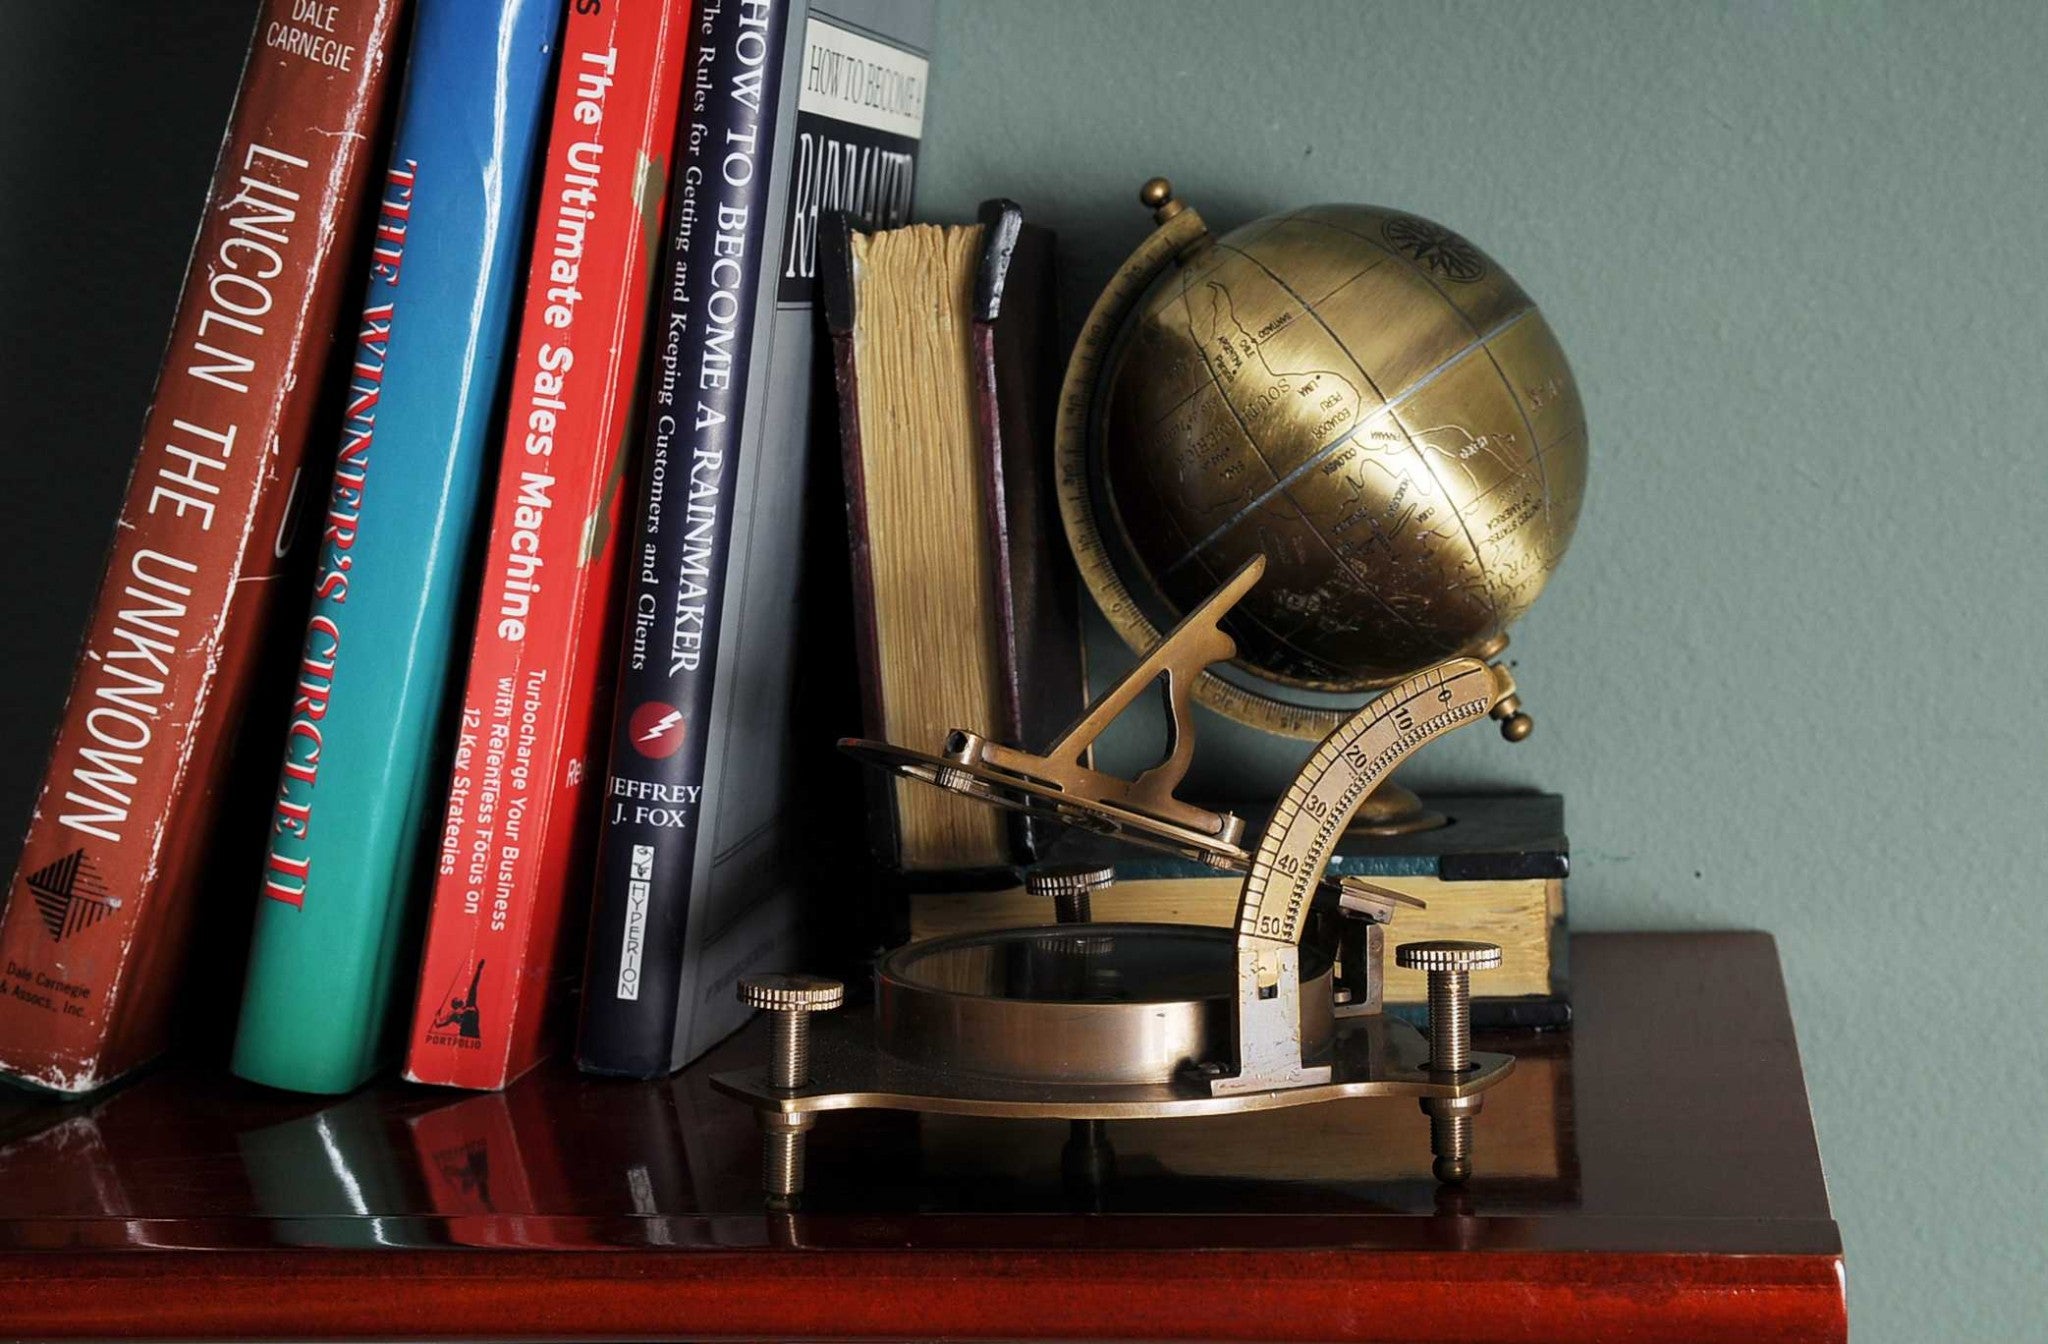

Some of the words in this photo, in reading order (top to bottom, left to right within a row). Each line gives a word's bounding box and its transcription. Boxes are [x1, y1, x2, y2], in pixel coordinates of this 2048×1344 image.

[292, 0, 340, 33] DALE
[266, 21, 356, 72] CARNEGIE
[730, 0, 771, 114] HOW
[807, 45, 845, 97] HOW
[573, 47, 618, 125] The
[693, 46, 716, 112] Rules
[689, 122, 708, 156] for
[722, 123, 758, 187] TO
[370, 159, 418, 287] THE
[543, 140, 604, 329] Ultimate
[676, 165, 703, 252] Getting
[188, 143, 309, 394] LINCOLN
[672, 260, 690, 302] and
[700, 201, 749, 390] BECOME
[658, 312, 687, 406] Keeping
[525, 342, 574, 457] Sales
[695, 400, 727, 431] A
[1298, 379, 1319, 397] LIMA
[1319, 391, 1343, 412] PERU
[1311, 407, 1352, 440] ECUADOR
[148, 418, 237, 531] THE
[646, 414, 676, 534] Customers
[1415, 506, 1436, 524] CUBA
[498, 471, 556, 642] Machine
[642, 543, 659, 584] and
[668, 447, 724, 678] RAINMAKER
[632, 593, 656, 671] Clients
[59, 549, 198, 842] UNKNOWN
[462, 707, 481, 729] 12
[493, 677, 513, 718] with
[1394, 707, 1414, 732] 10
[275, 615, 340, 841] CIRCLE
[454, 733, 478, 771] Key
[511, 669, 547, 791] Turbocharge
[477, 723, 510, 824] Relentless
[1347, 744, 1368, 769] 20
[608, 776, 702, 804] JEFFREY
[612, 803, 627, 825] J.
[635, 806, 687, 829] FOX
[1306, 793, 1327, 818] 30
[440, 775, 472, 876] Strategies
[505, 796, 528, 841] Your
[264, 853, 310, 913] II
[468, 826, 493, 885] Focus
[1278, 853, 1298, 874] 40
[464, 890, 479, 914] on
[490, 846, 520, 932] Business
[619, 883, 648, 998] HYPERION
[1260, 916, 1280, 936] 50
[35, 971, 91, 999] Carnegie
[425, 1033, 482, 1050] PORTFOLIO
